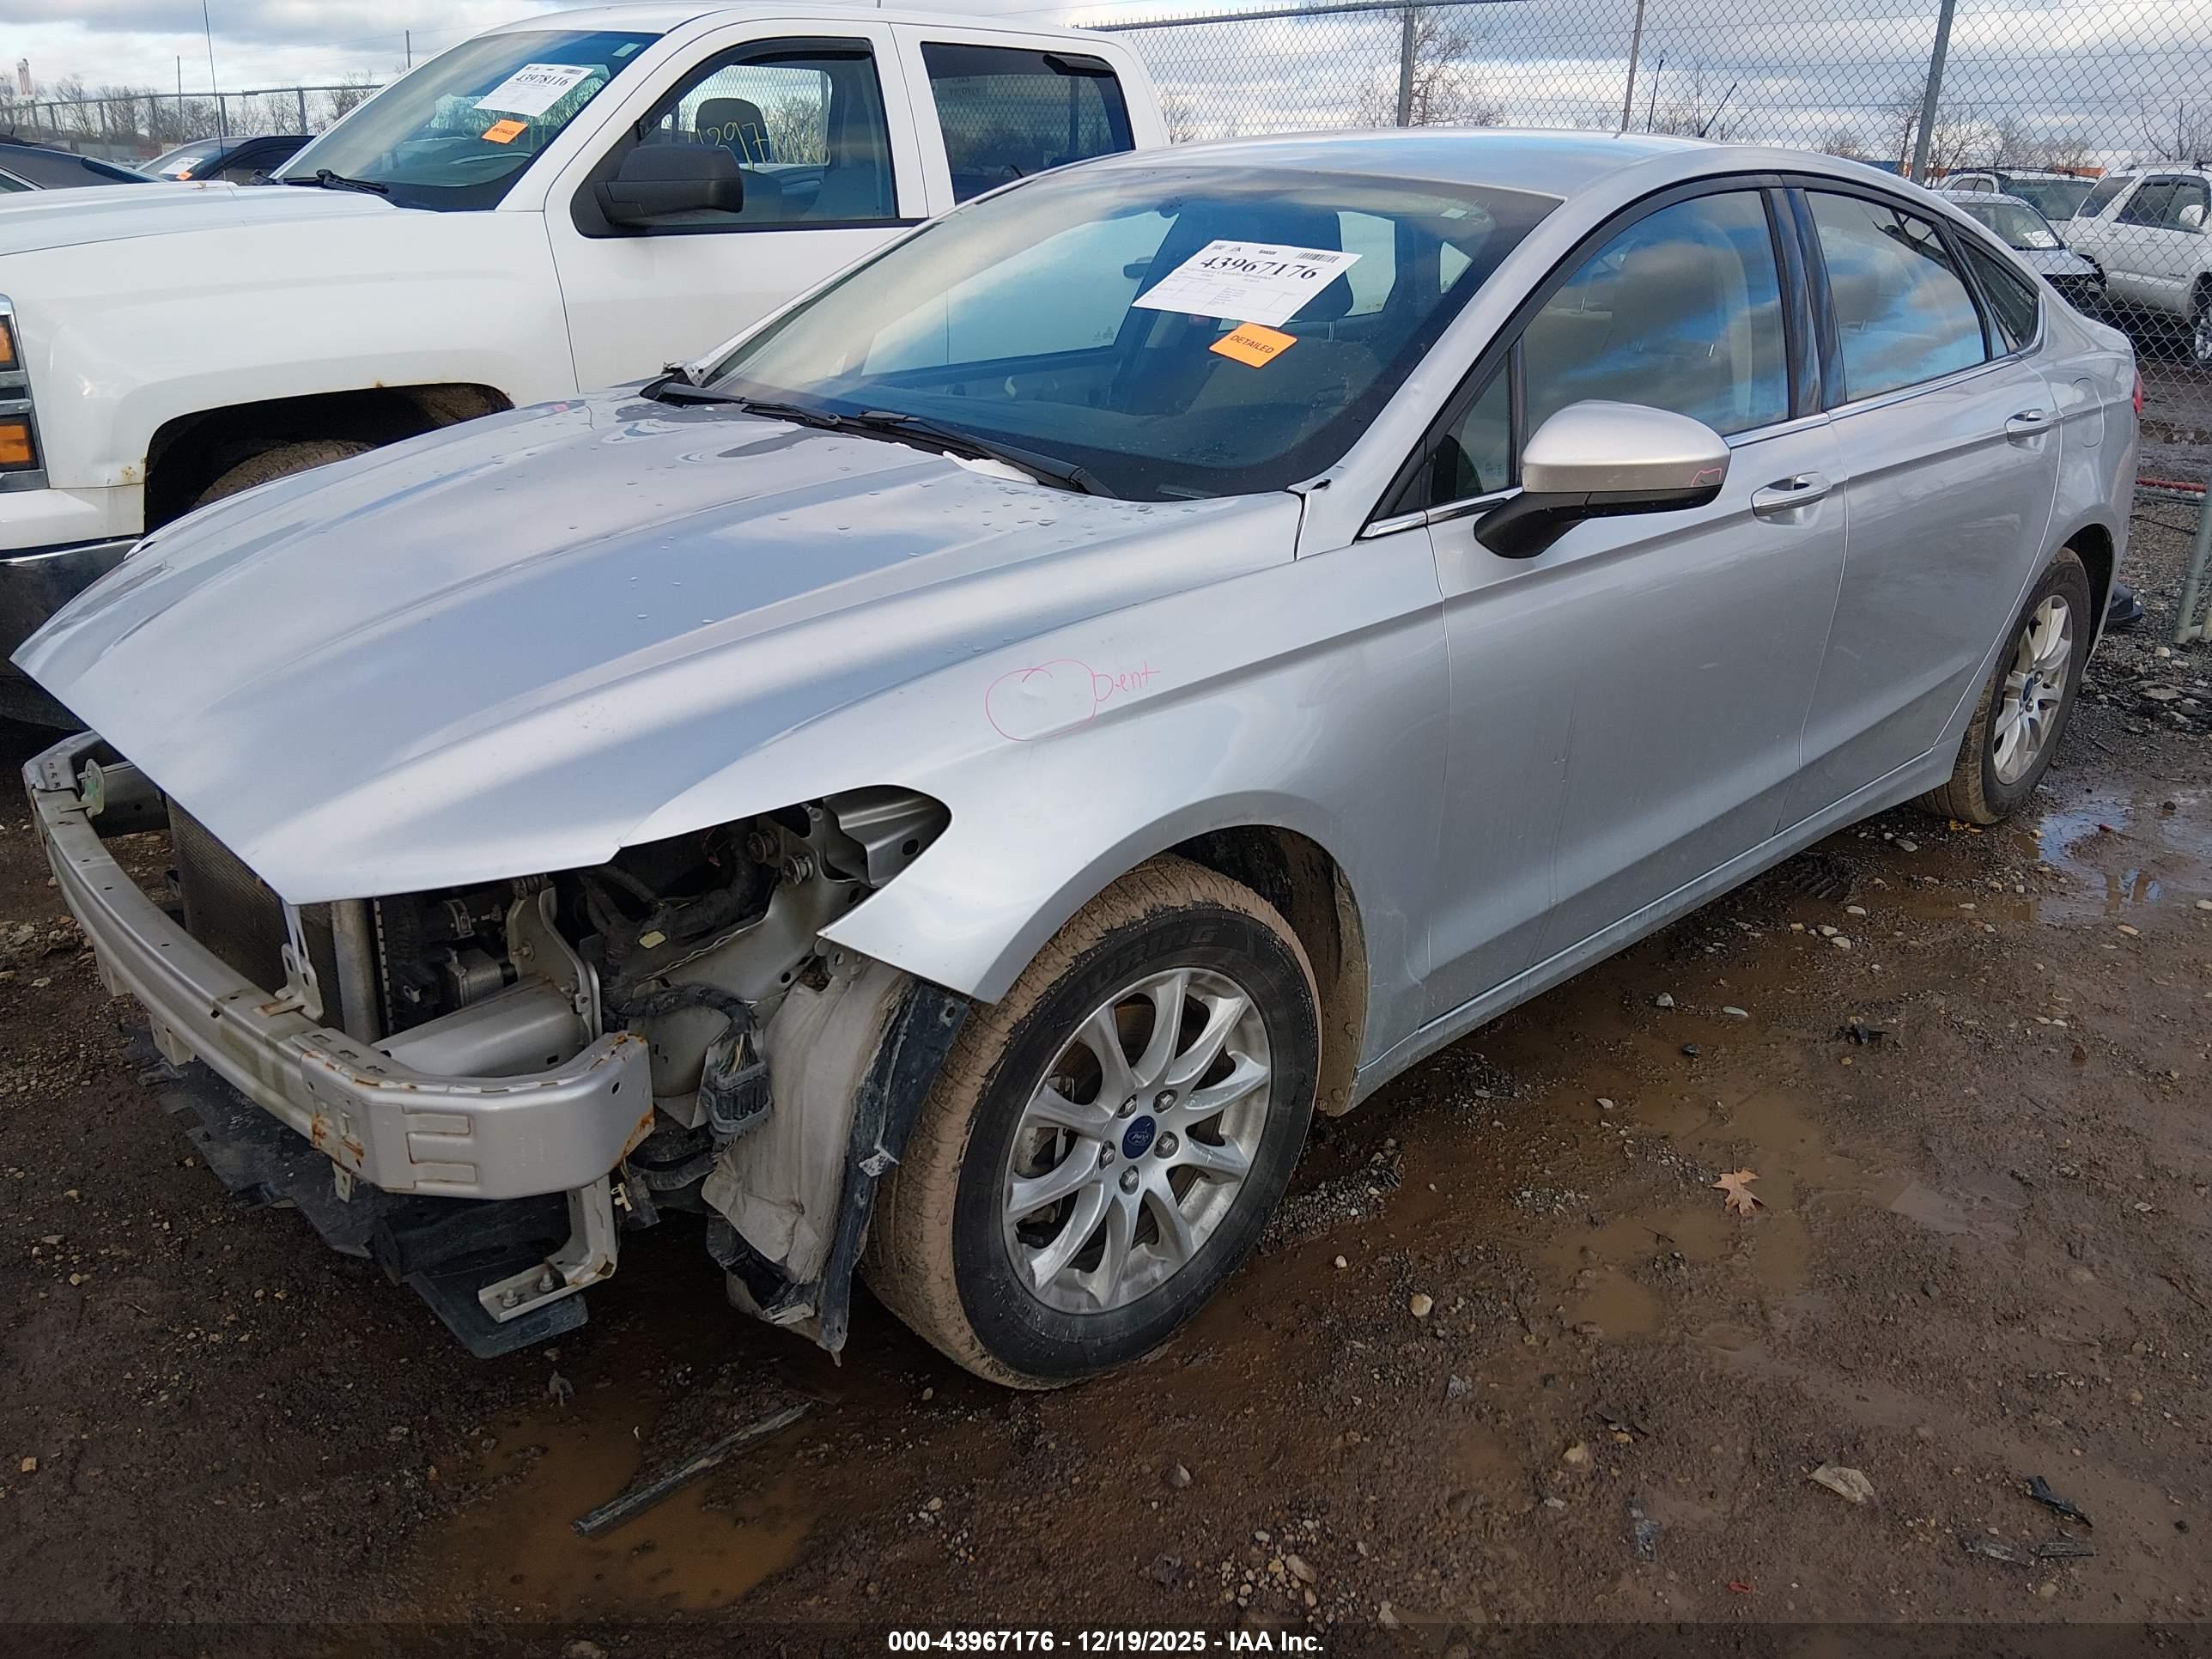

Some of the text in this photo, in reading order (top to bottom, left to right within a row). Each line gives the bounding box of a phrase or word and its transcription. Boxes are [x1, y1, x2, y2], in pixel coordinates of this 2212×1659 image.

[515, 73, 570, 87] 43978116
[1200, 255, 1323, 281] 43967176
[1229, 334, 1275, 354] DETAILED
[1091, 659, 1162, 702] Dent
